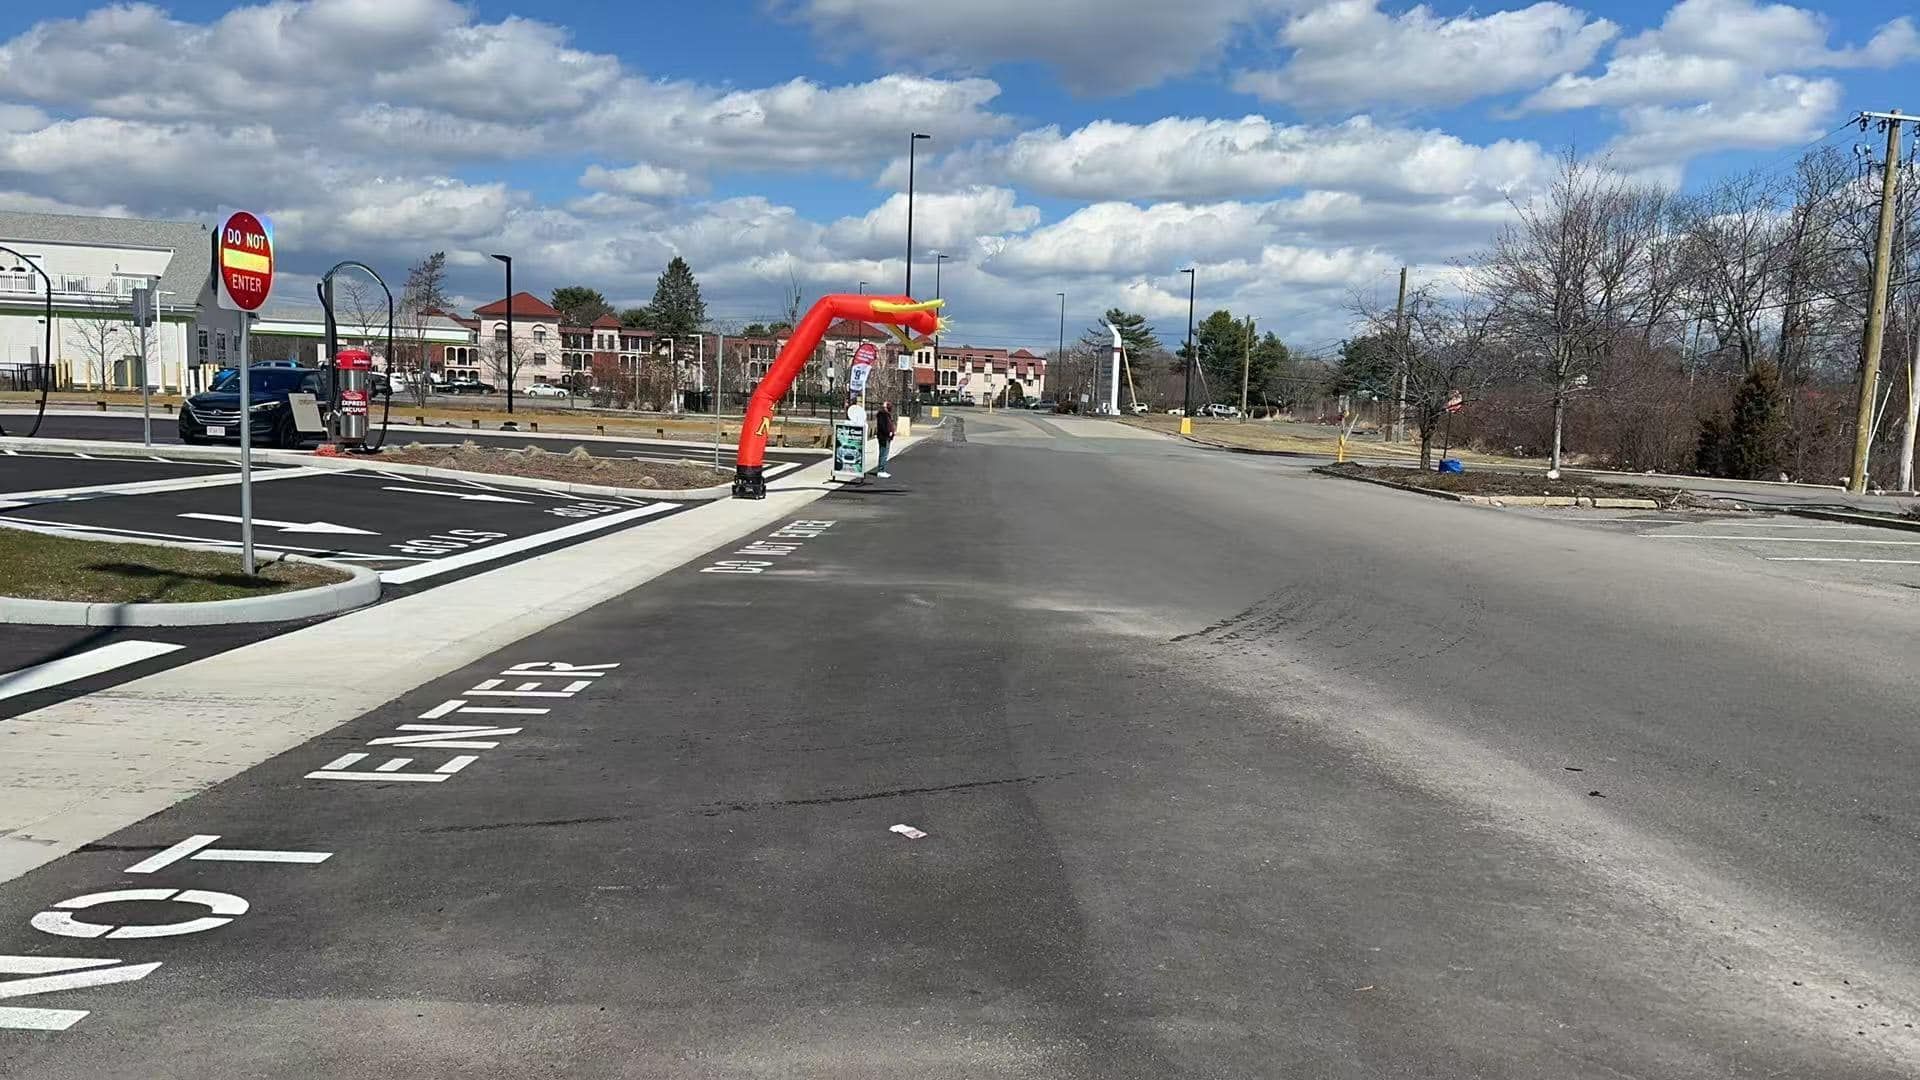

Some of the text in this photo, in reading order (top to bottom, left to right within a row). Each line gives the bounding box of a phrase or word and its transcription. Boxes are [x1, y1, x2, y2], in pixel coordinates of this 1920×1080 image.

[227, 228, 265, 250] DO NOT
[232, 274, 262, 293] ENTER
[389, 529, 507, 554] STOP
[700, 520, 837, 573] DO NOT ENTER
[0, 661, 620, 1031] NOT ENTER
